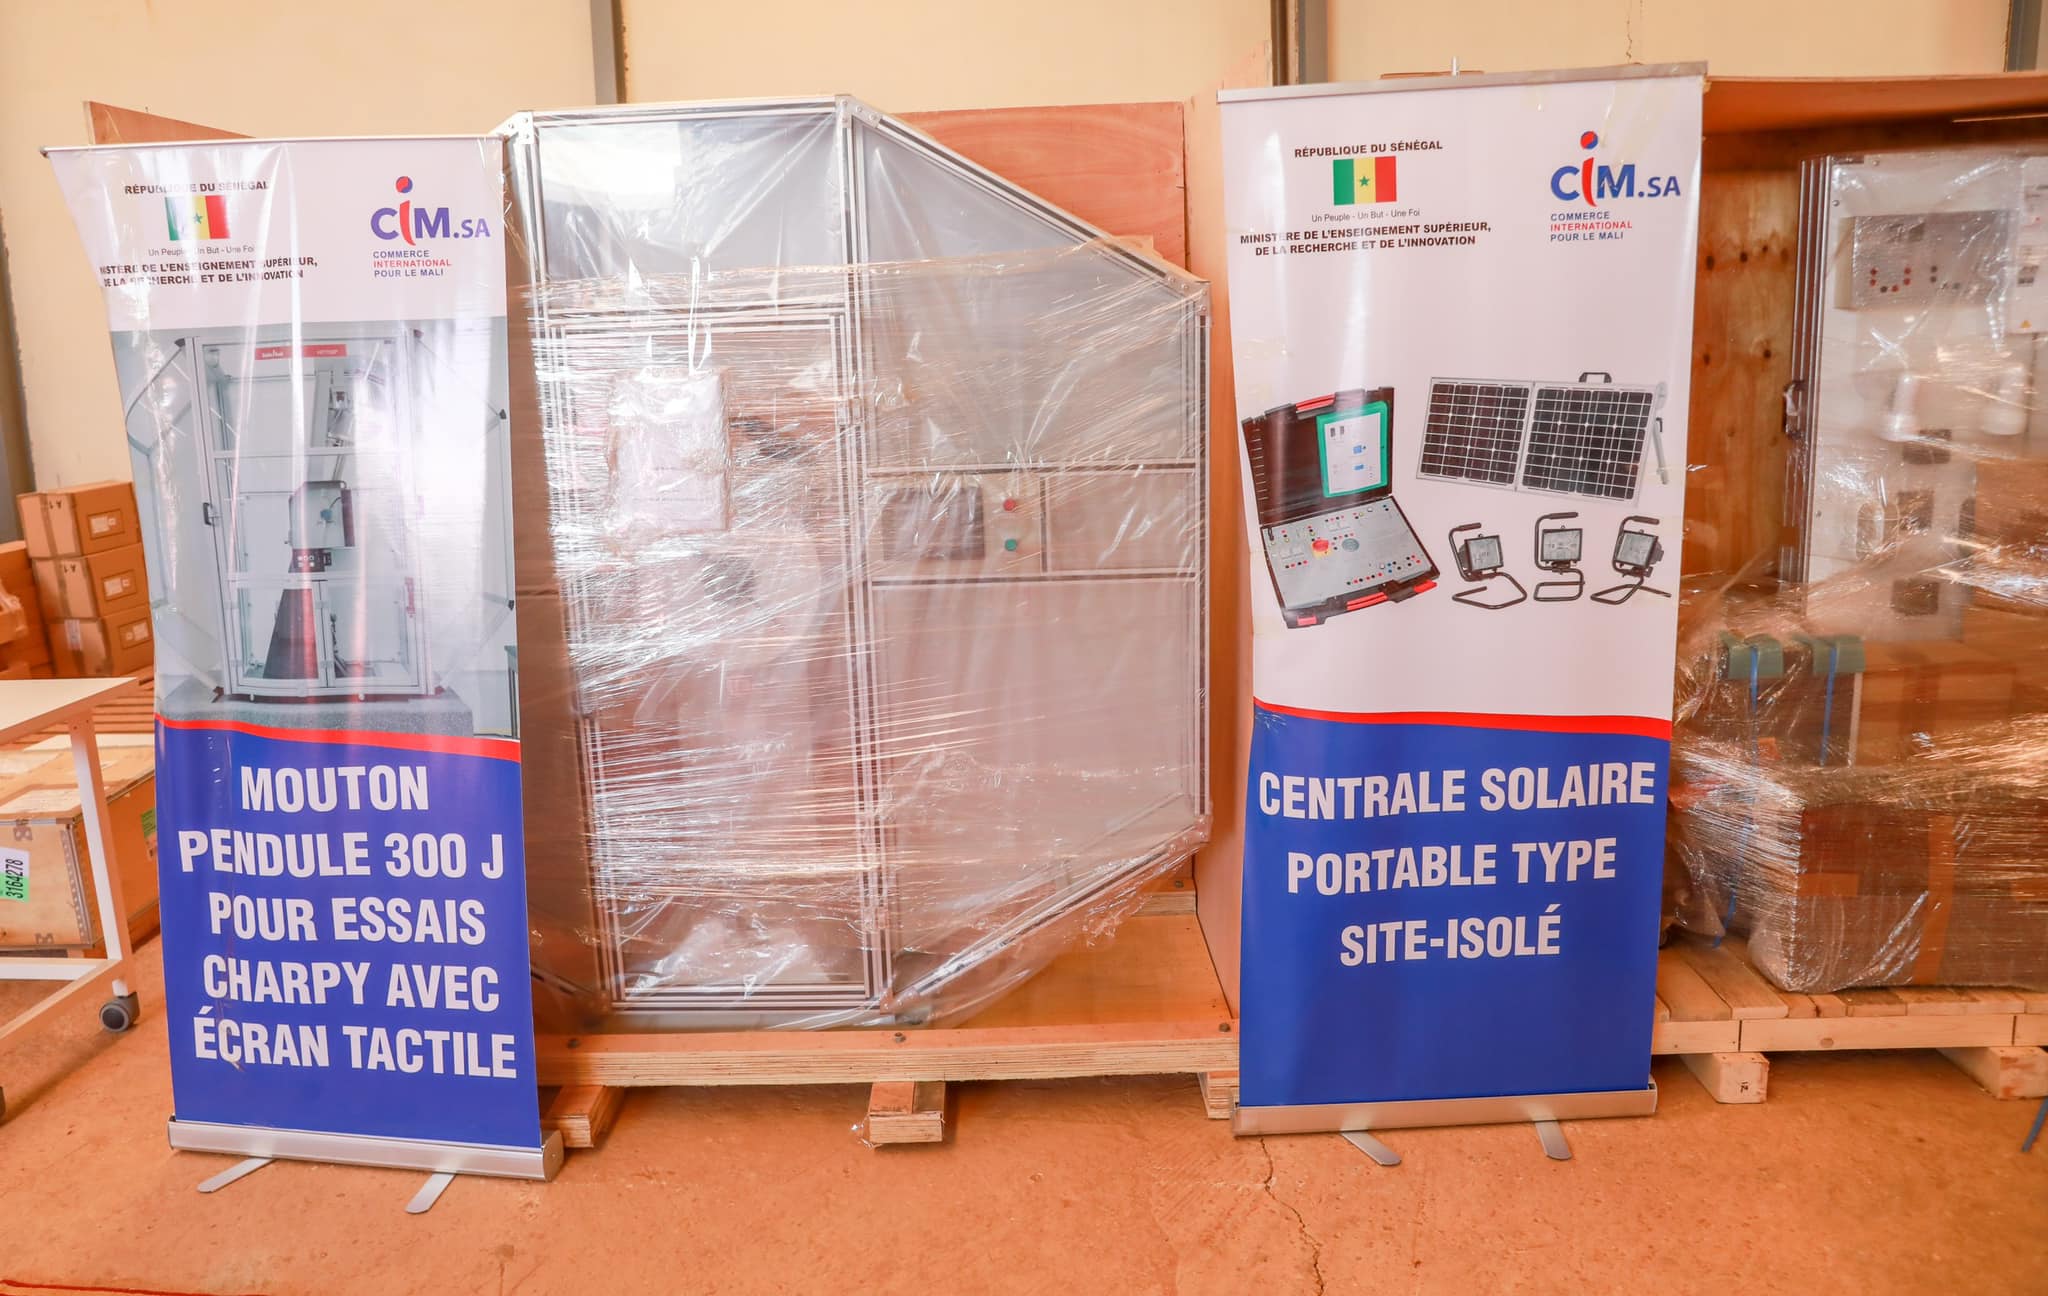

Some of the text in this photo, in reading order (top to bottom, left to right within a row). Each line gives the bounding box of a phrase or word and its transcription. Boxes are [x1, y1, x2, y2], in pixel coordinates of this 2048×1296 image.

[1294, 139, 1443, 158] RÉPUBLIQUE DU SÉNÉGAL
[199, 182, 216, 192] DU
[1311, 213, 1323, 222] Un
[1324, 212, 1351, 223] Peuple
[1357, 211, 1369, 220] Un
[1370, 210, 1384, 219] But
[1390, 208, 1407, 218] Une
[1408, 208, 1421, 217] Foi
[1550, 211, 1610, 221] COMMERCE
[1240, 221, 1491, 245] MINISTRE DE L'ENSEIGNEMENT SUPÉRIEUR,
[1550, 220, 1633, 232] INTERNATIONAL
[1255, 235, 1476, 256] DE LA RECHERCHE ET DE L'INNOVATION
[1550, 231, 1624, 242] POUR LE MALI
[206, 245, 220, 255] But
[373, 249, 430, 259] COMMERCE
[160, 259, 256, 273] L'ENSIGNEMENT
[373, 258, 452, 269] INTERNATIONAL
[374, 267, 444, 278] POUR LE MALI
[201, 273, 215, 284] ET
[218, 272, 233, 283] DE
[240, 765, 429, 813] MOUTON
[1259, 762, 1655, 820] CENTRALE SOLAIRE
[178, 829, 504, 879] PENDULE 300 J
[1288, 837, 1617, 896] PORTABLE TYPE
[5, 858, 24, 899] 3164278
[208, 892, 486, 946] POUR ESSAIS
[1340, 903, 1561, 967] SITE-ISOLÉ
[203, 954, 500, 1012] CHARPY AVEC
[193, 1006, 517, 1079] ÉCRAN TACTILE
